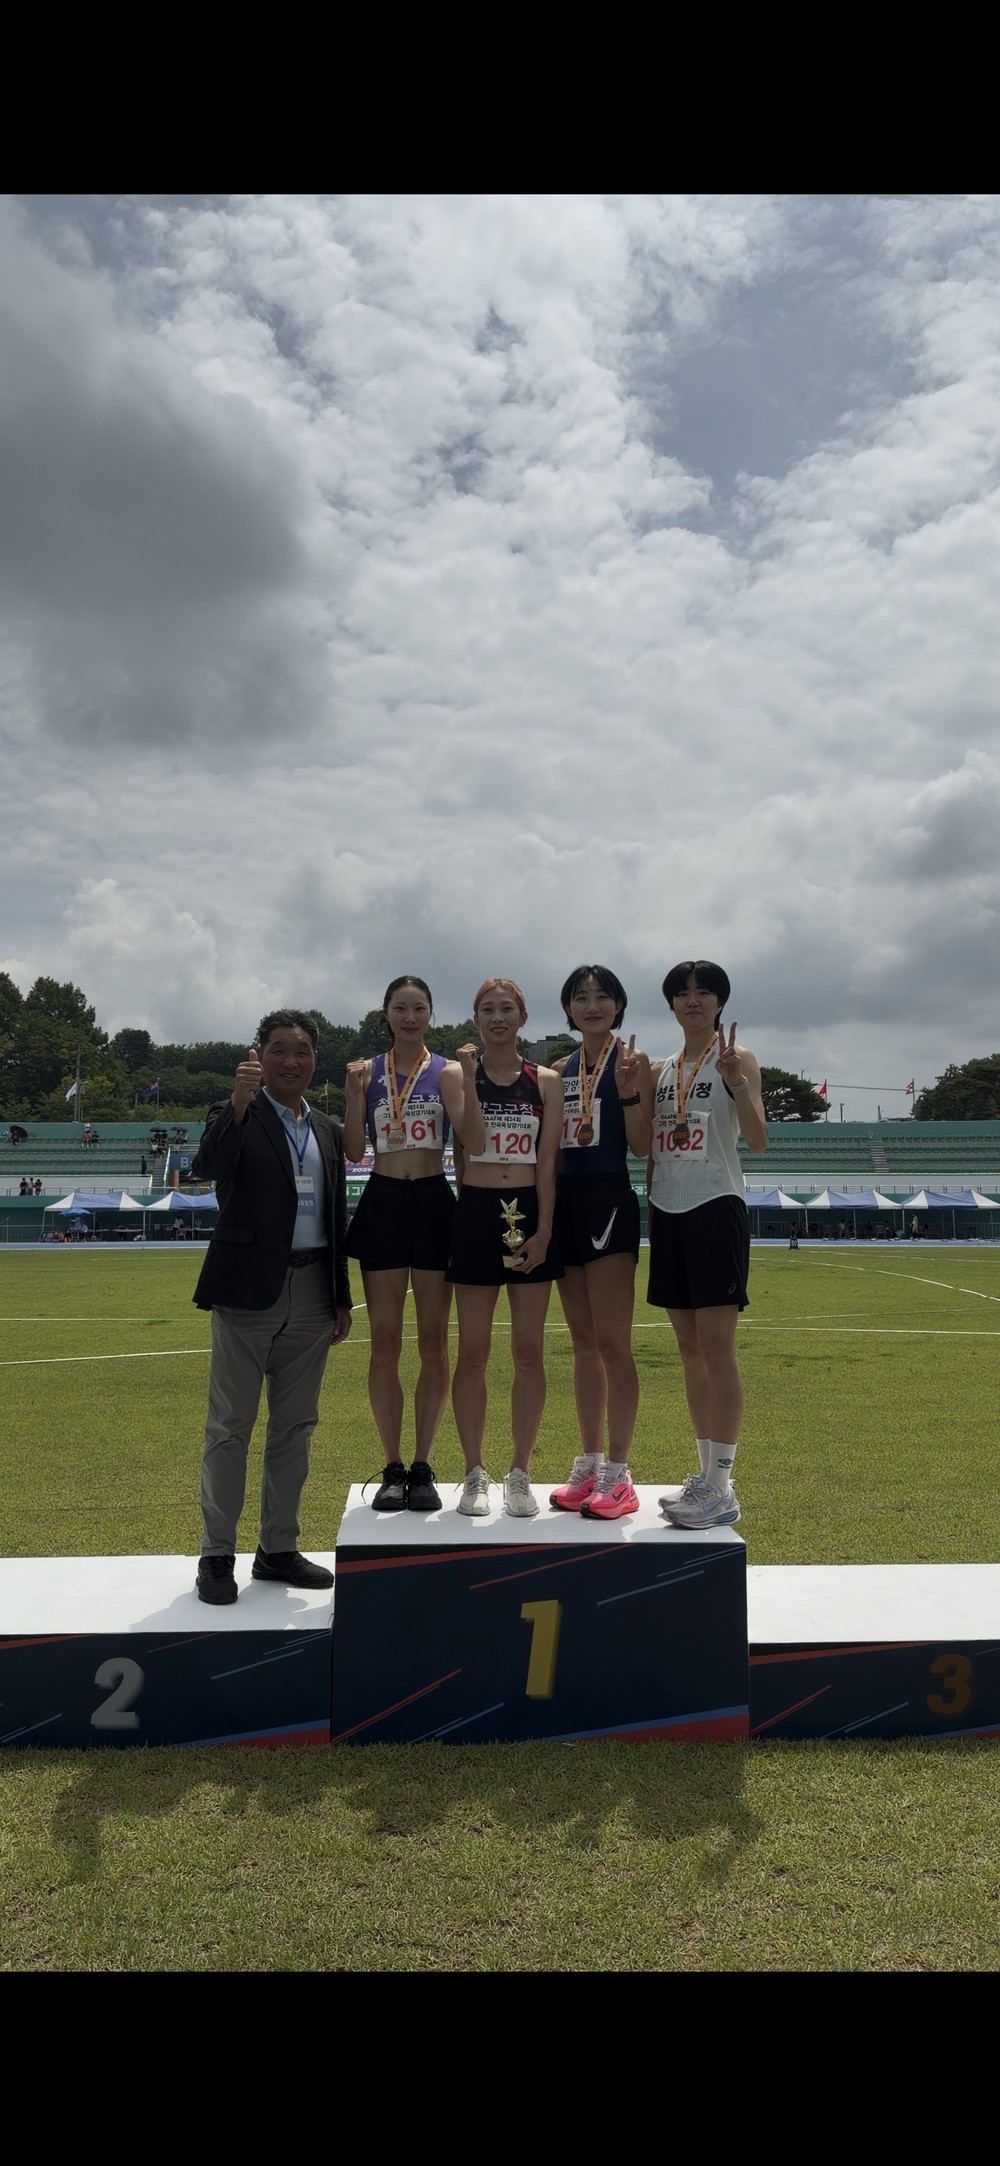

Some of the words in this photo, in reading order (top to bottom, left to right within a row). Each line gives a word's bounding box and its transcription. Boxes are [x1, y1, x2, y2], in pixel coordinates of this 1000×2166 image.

[483, 1132, 532, 1155] 120
[520, 1599, 562, 1700] 1
[90, 1657, 145, 1730] 2
[927, 1653, 972, 1716] 3
